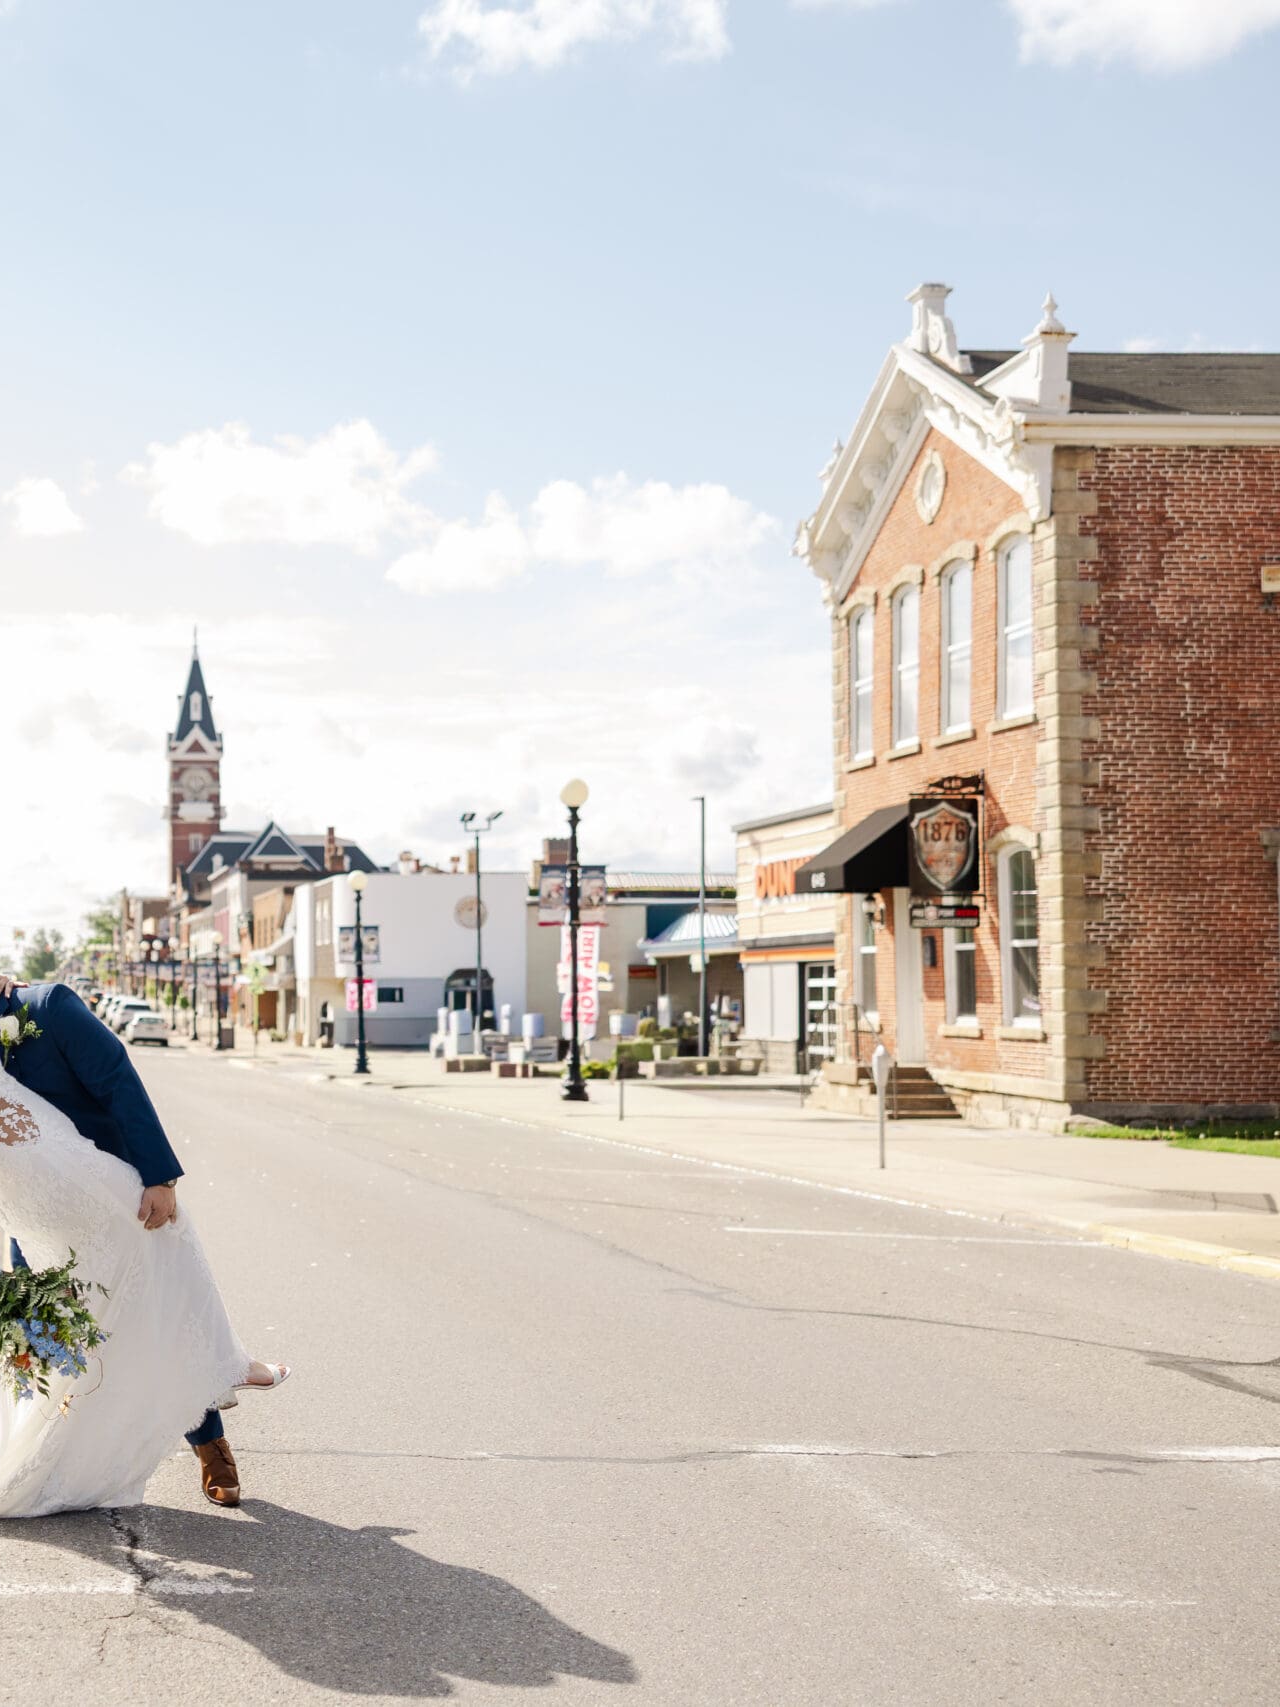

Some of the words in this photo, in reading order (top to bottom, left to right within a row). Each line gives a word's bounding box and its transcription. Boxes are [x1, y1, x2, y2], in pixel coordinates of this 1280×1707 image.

[923, 821, 966, 842] 1876
[581, 929, 595, 968] HIRI
[580, 975, 595, 1024] NOW
